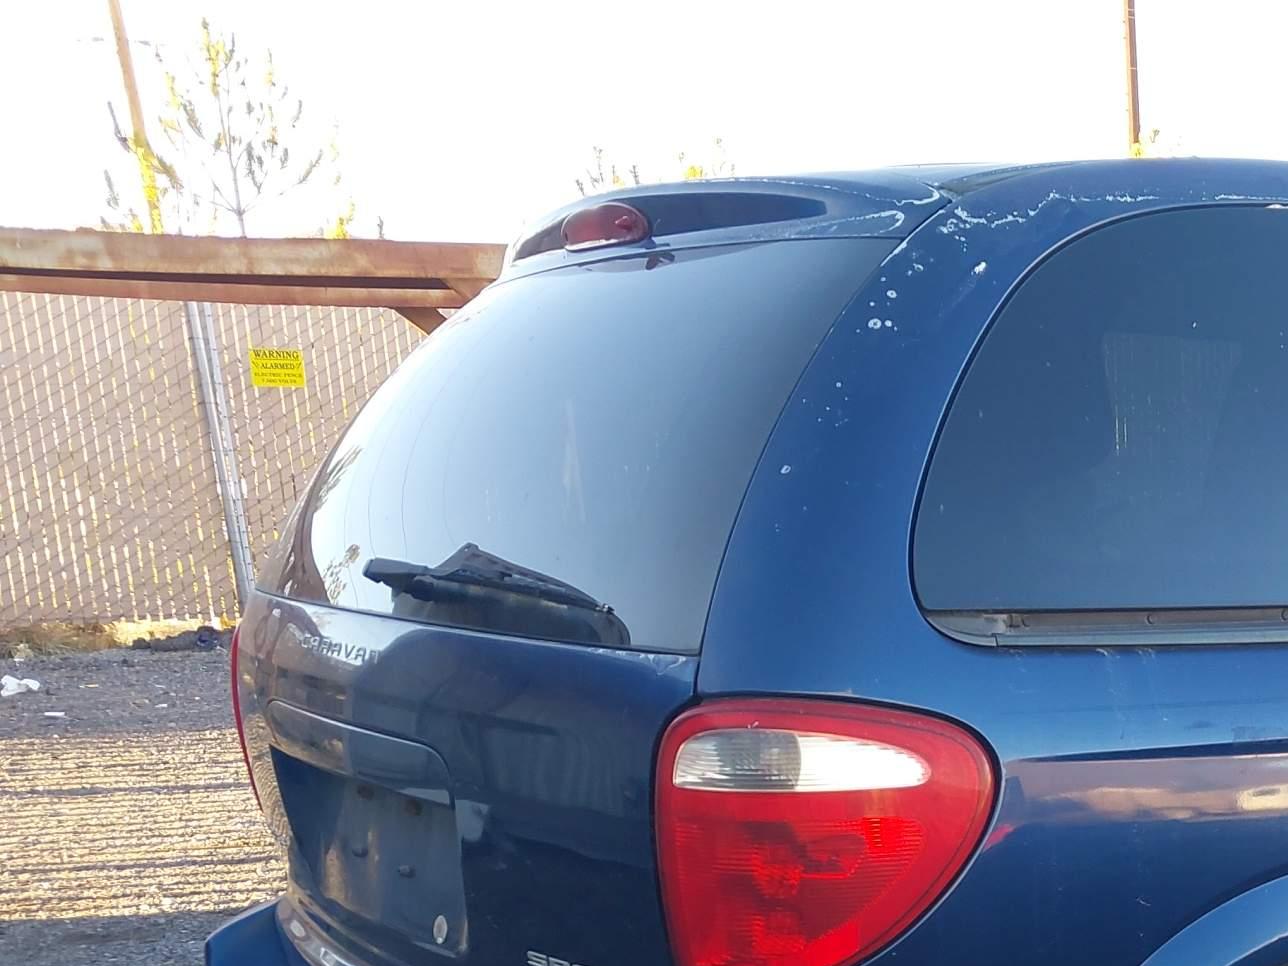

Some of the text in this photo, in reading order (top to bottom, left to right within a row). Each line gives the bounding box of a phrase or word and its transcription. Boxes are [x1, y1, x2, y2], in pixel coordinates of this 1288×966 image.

[253, 349, 299, 360] WARNING
[261, 362, 295, 370] ALARMED
[301, 632, 379, 664] CARAVAN
